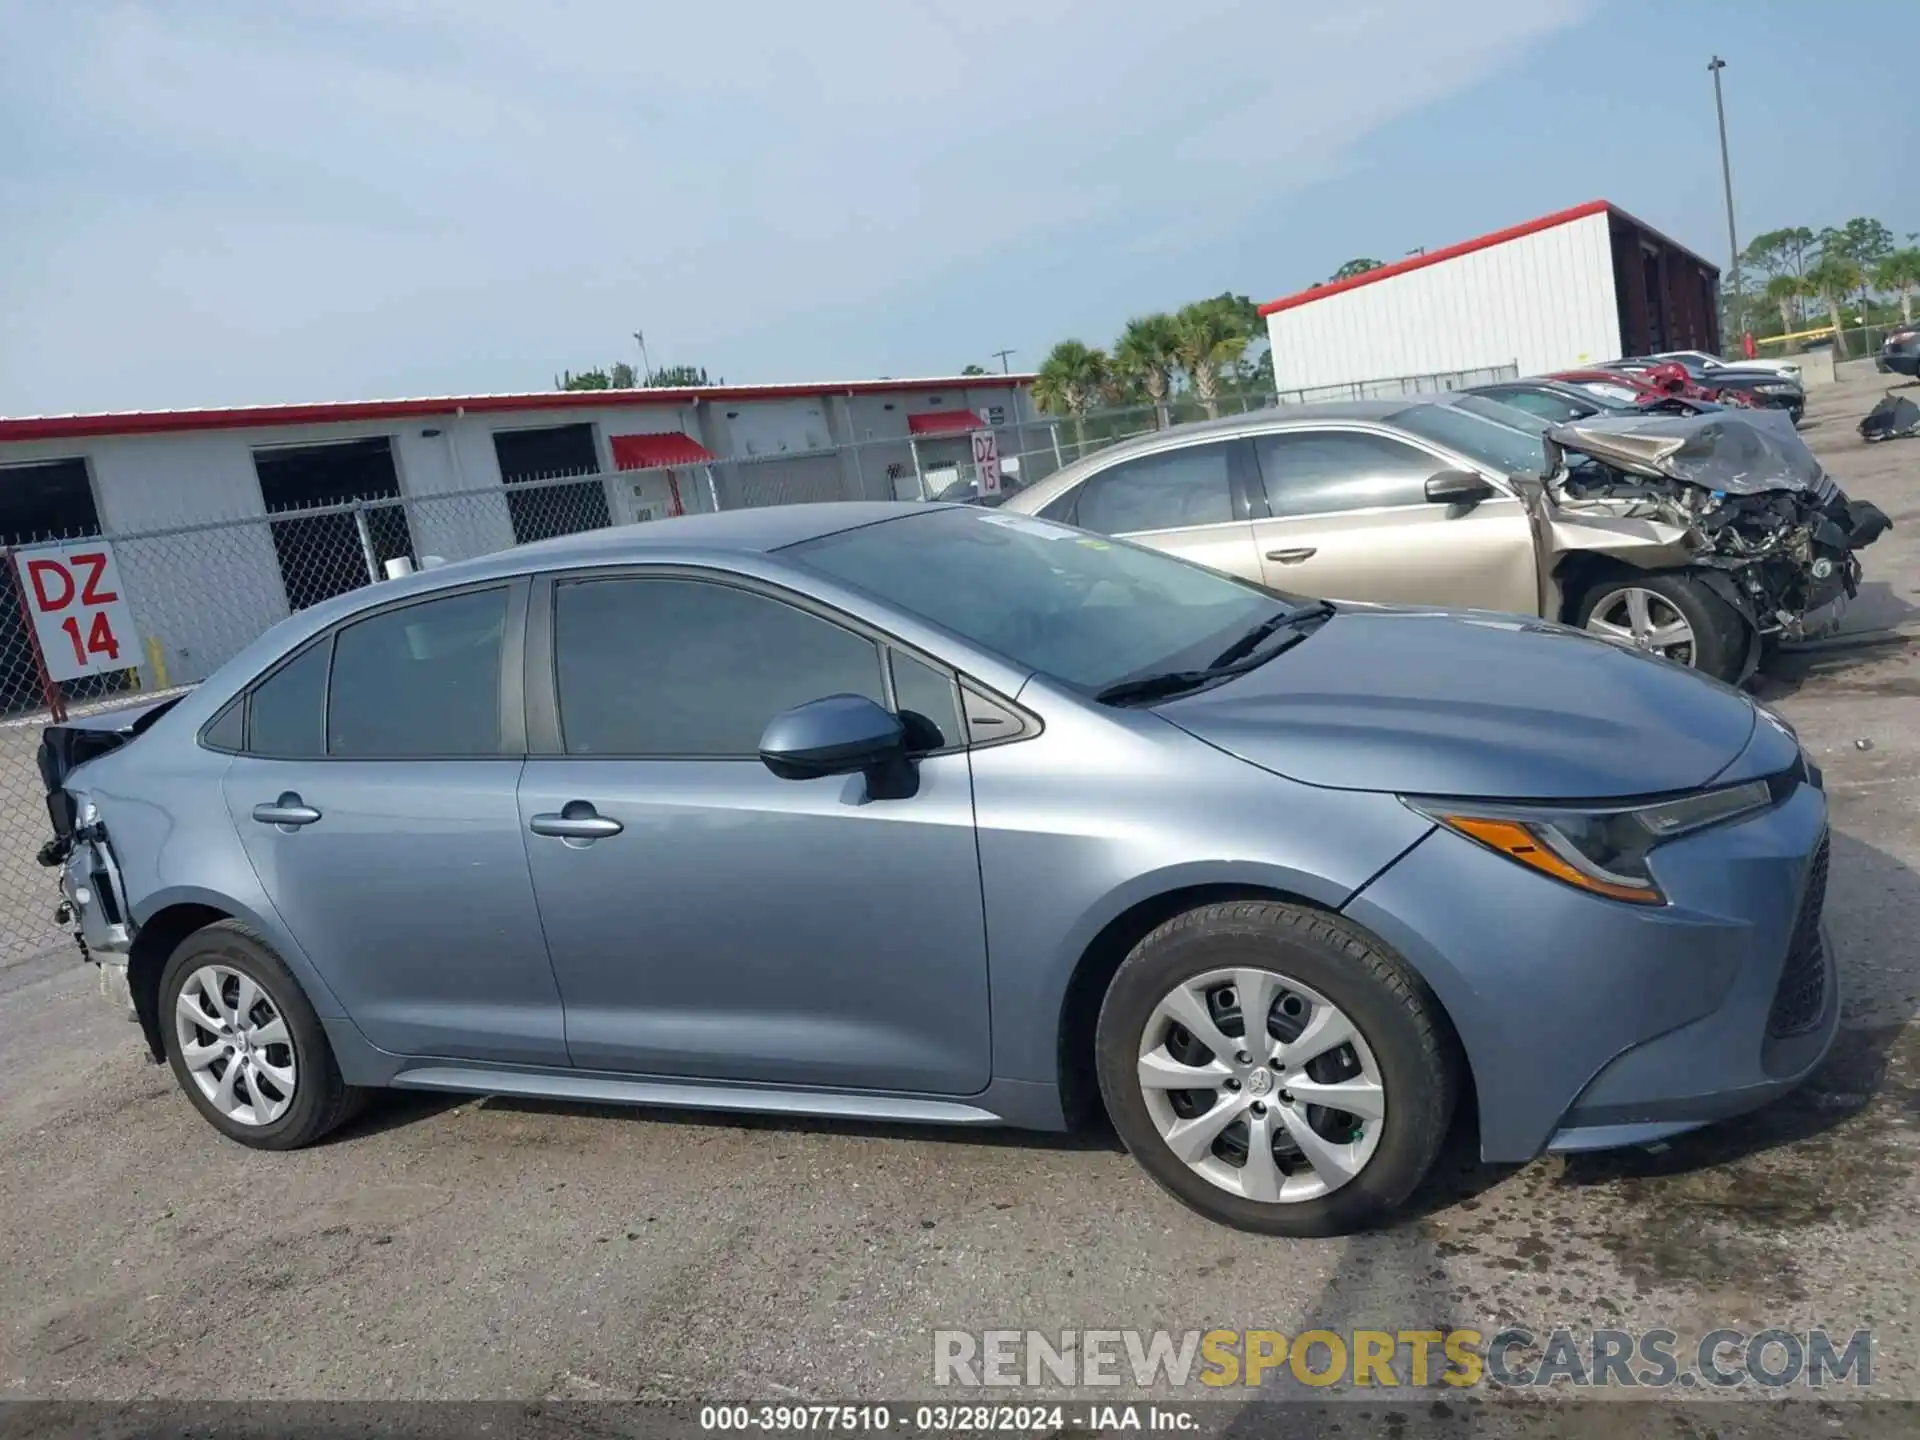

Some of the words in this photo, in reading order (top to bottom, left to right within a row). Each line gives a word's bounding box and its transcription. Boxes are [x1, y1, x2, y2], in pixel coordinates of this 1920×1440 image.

[975, 436, 996, 462] DZ
[982, 465, 996, 491] 15
[27, 552, 119, 612] DZ
[62, 611, 120, 666] 14
